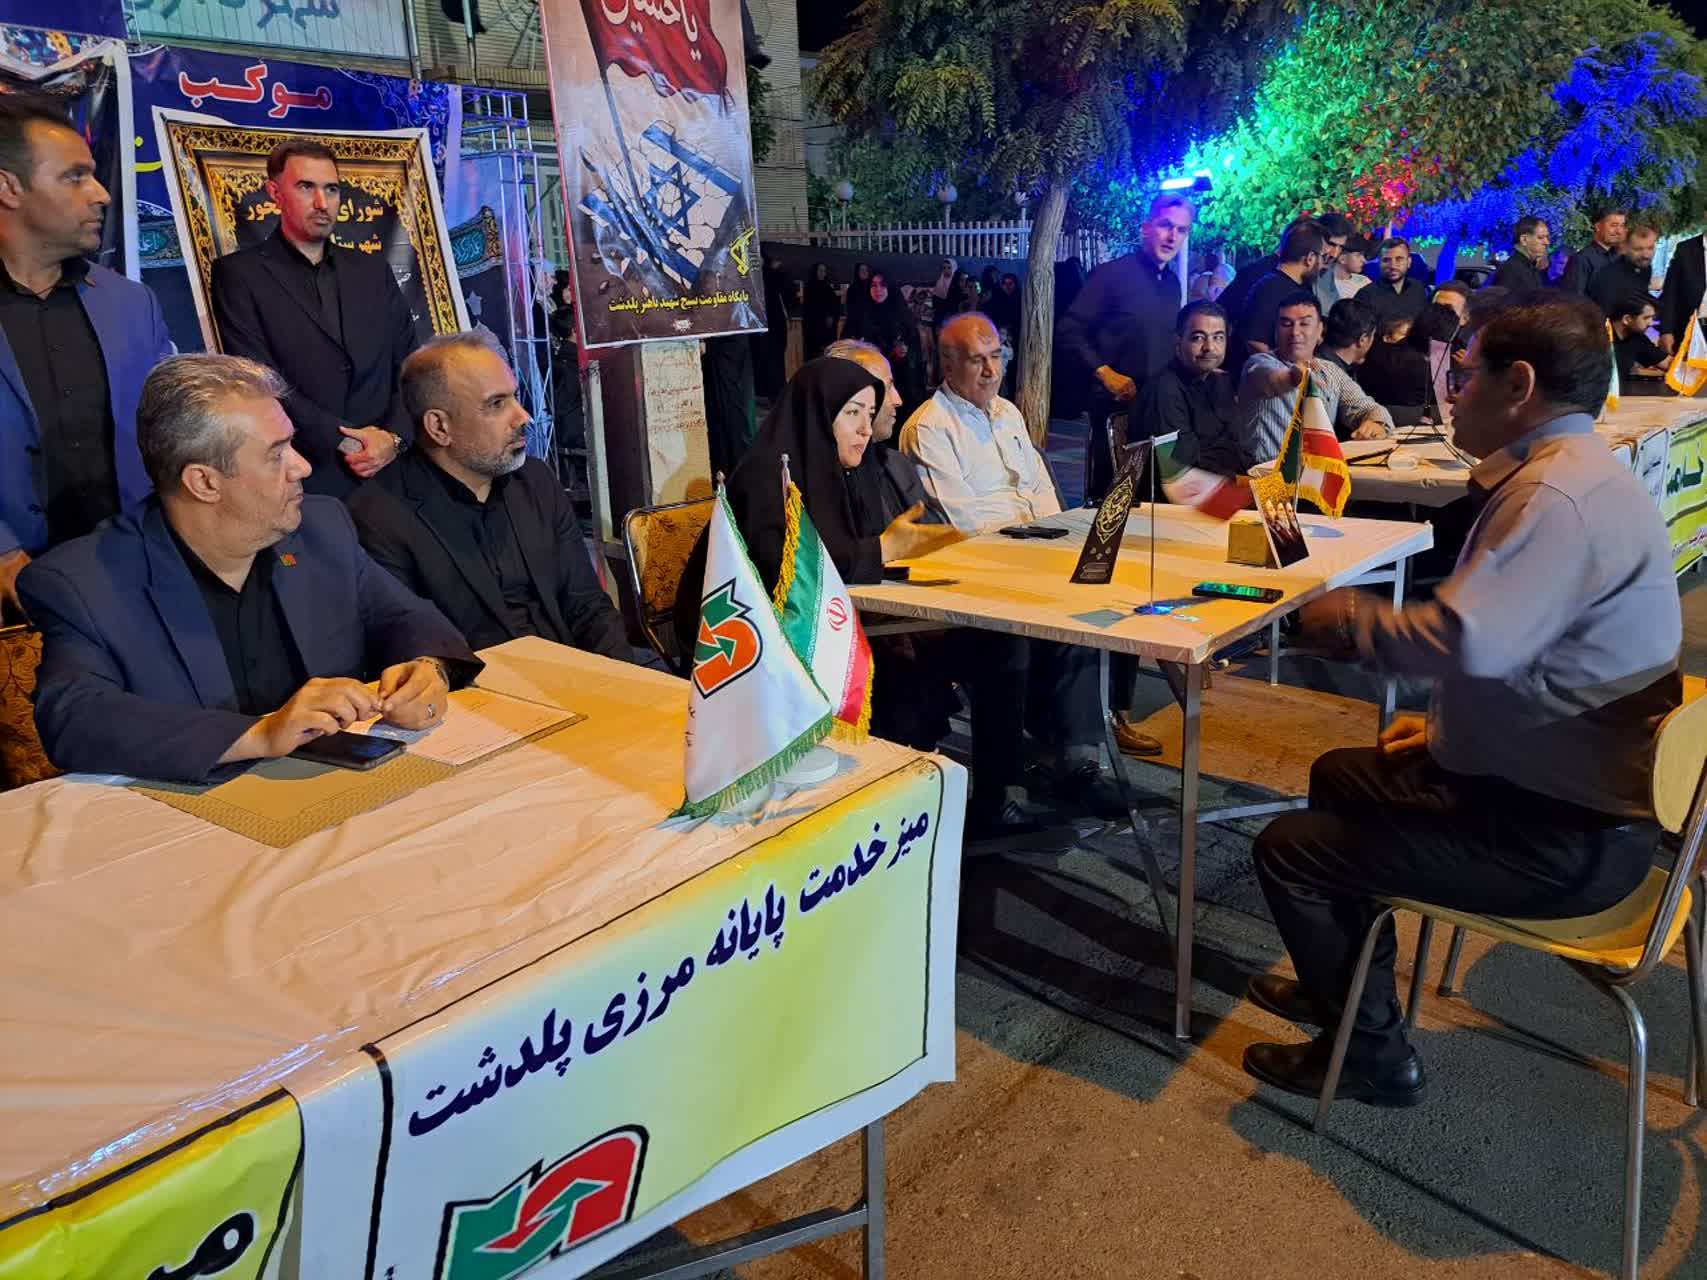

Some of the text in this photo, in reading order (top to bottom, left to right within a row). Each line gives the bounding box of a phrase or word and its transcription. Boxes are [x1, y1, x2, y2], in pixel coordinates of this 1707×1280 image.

[178, 63, 333, 119] موکب
[247, 198, 385, 222] شورای حور
[329, 232, 383, 255] شهرستا
[608, 295, 640, 313] پلدشت
[660, 294, 680, 310] شهید
[680, 296, 698, 310] بسیج
[407, 809, 929, 1138] میز خدمت پایانه مرزی پلدشت
